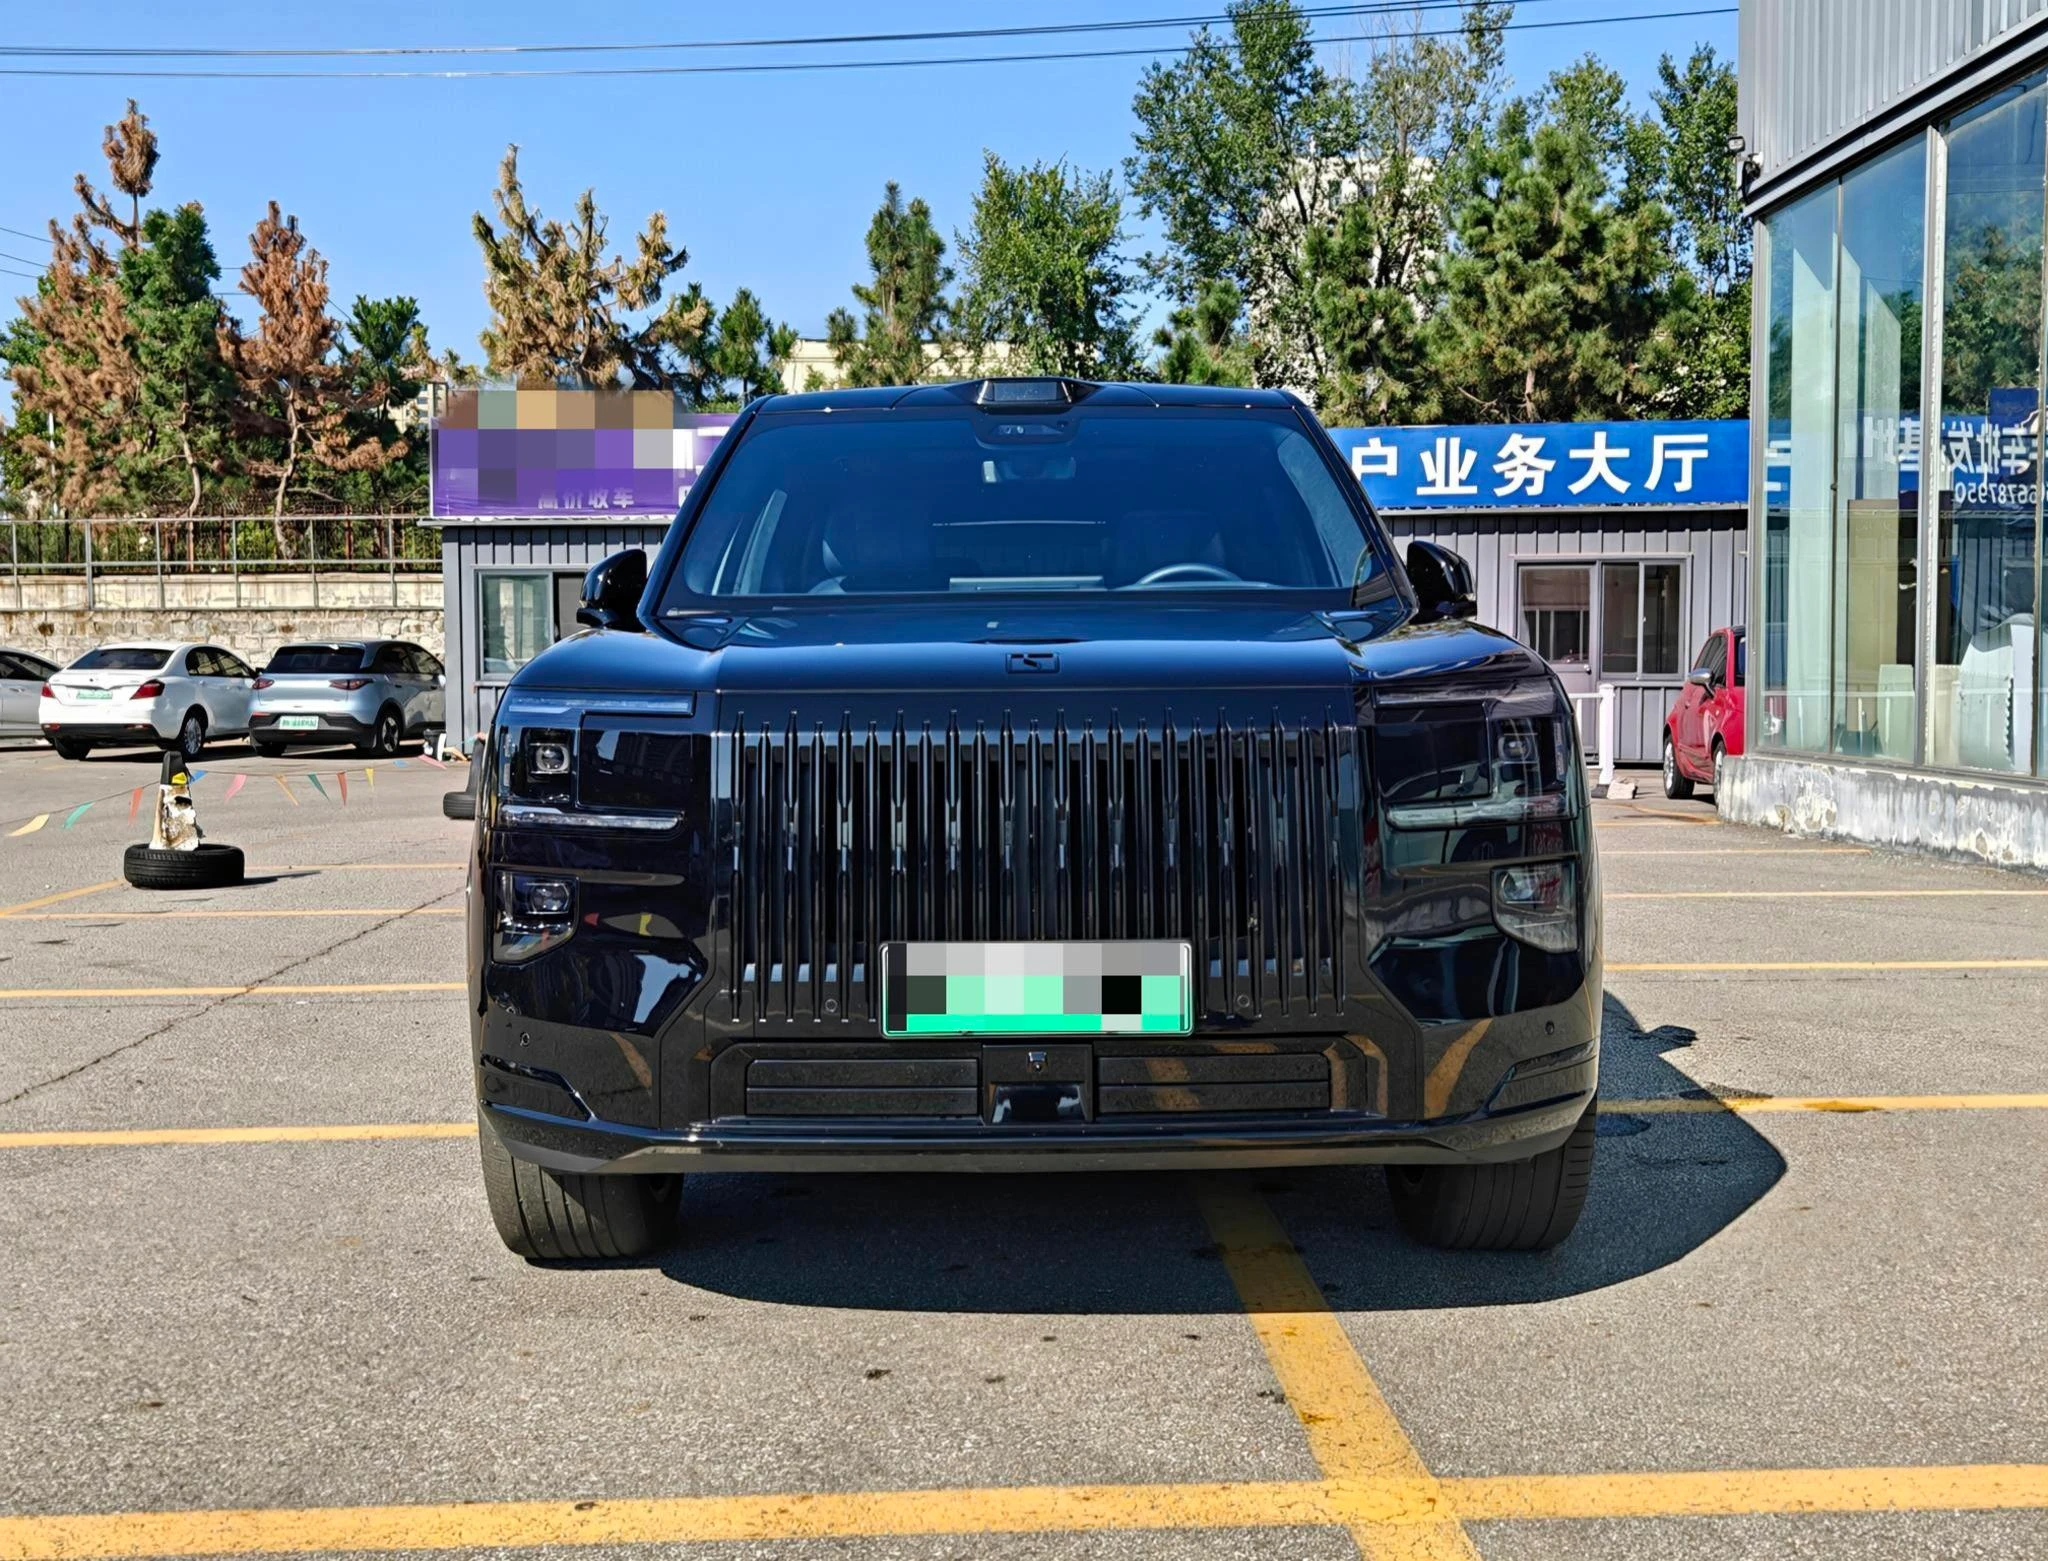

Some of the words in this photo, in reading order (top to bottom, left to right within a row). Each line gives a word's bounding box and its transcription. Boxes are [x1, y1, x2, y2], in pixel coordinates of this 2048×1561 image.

[1351, 431, 1709, 497] 户业务大厅
